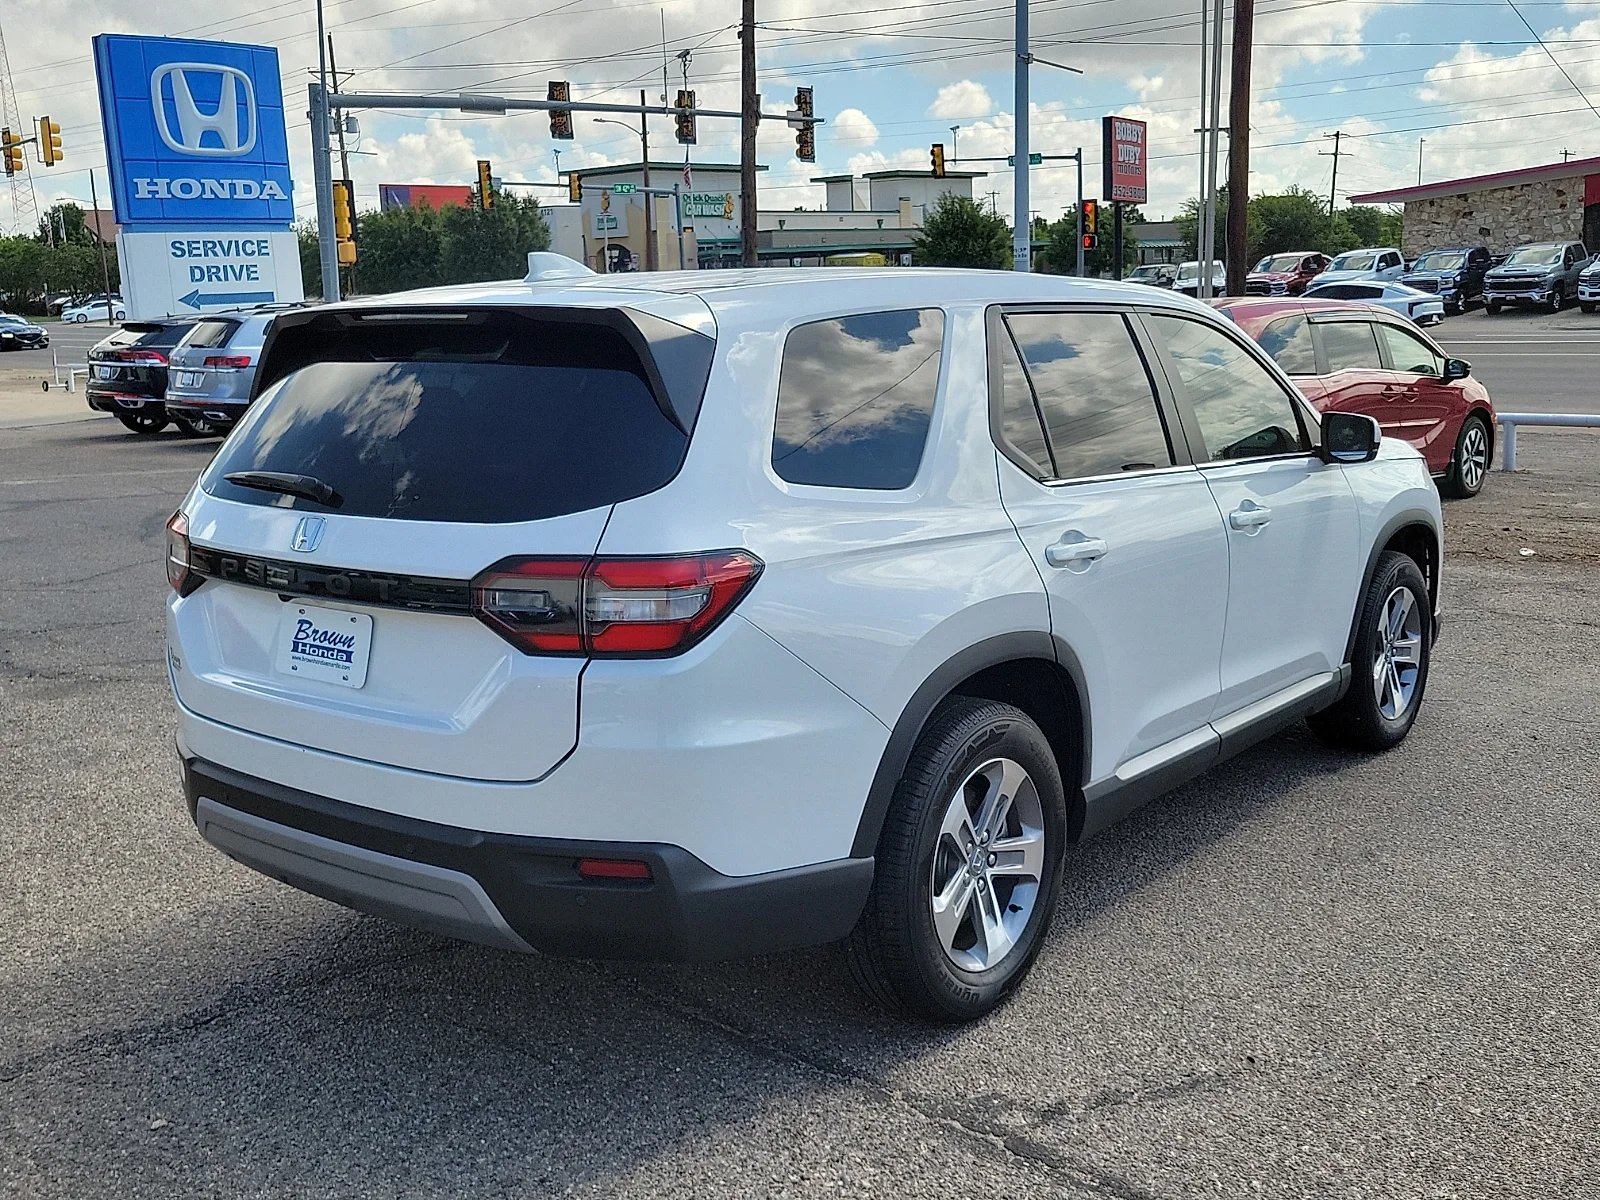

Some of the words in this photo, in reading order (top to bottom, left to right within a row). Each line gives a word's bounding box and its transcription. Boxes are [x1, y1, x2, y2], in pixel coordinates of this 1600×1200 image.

[1115, 122, 1143, 143] BOBBY
[1118, 144, 1140, 164] DUBY
[1117, 164, 1141, 175] motors
[133, 178, 288, 200] HONDA
[686, 204, 701, 215] CAR
[702, 204, 725, 215] WASH
[170, 239, 270, 258] SERVICE
[189, 264, 260, 283] DRIVE
[294, 618, 356, 649] Brown
[297, 642, 347, 661] Honda
